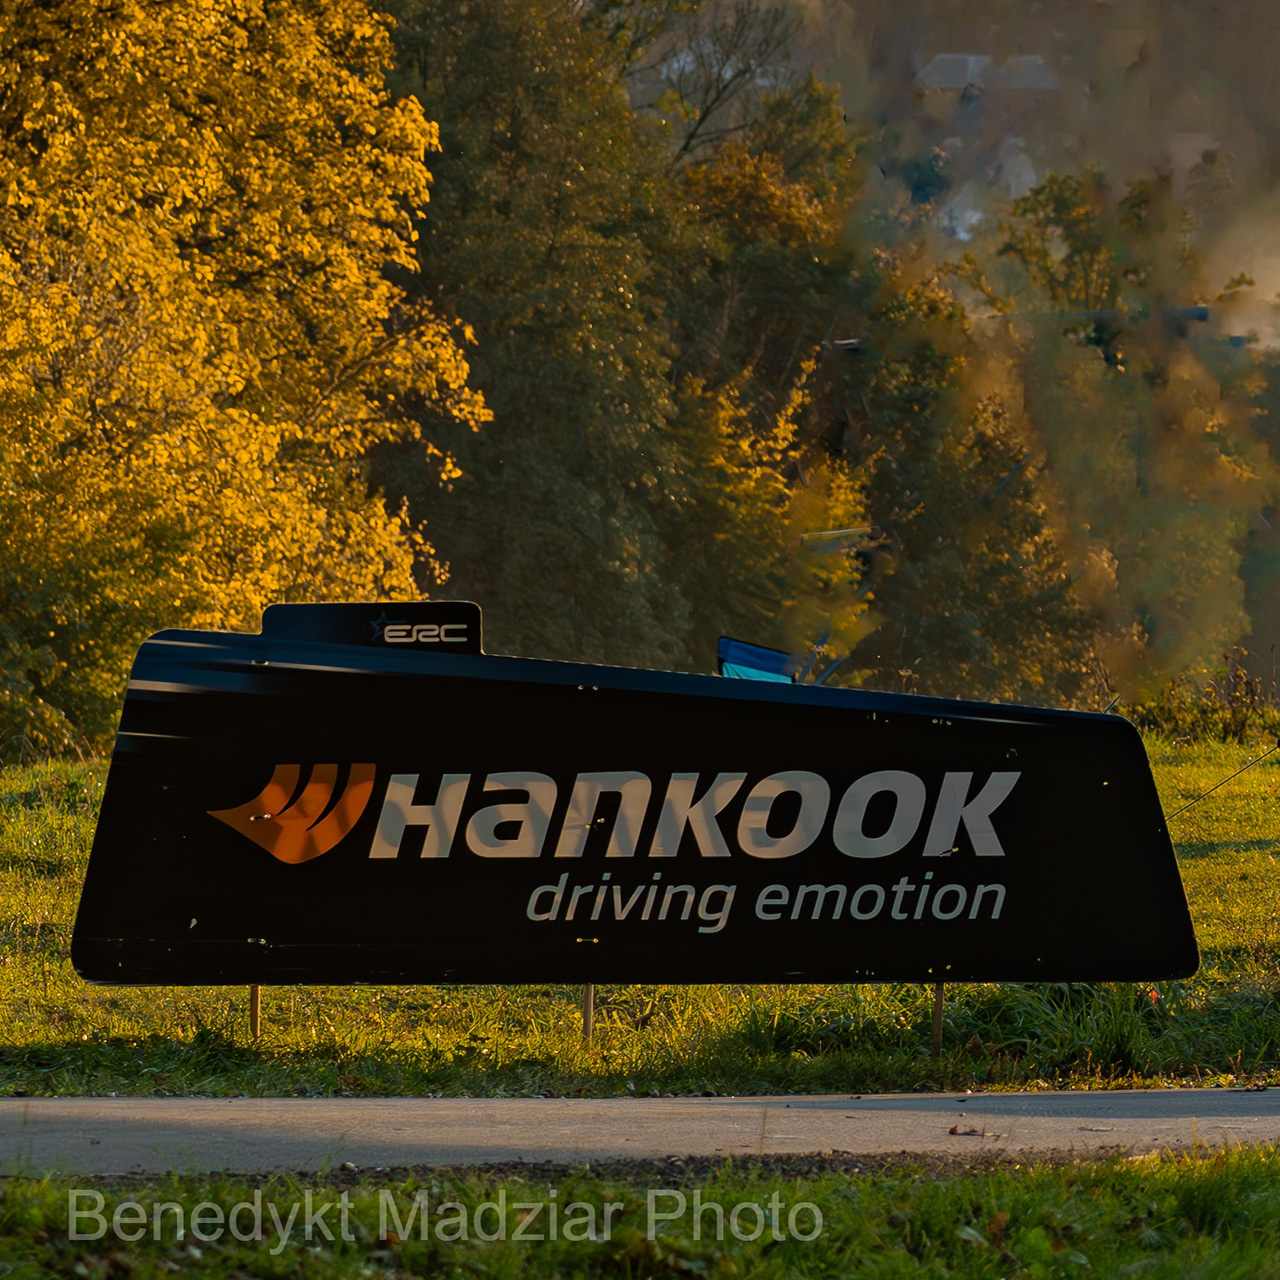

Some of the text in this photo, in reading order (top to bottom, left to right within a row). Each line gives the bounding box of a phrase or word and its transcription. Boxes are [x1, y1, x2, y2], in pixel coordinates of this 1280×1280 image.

[383, 623, 468, 643] ERC
[525, 871, 1007, 934] driving emotion
